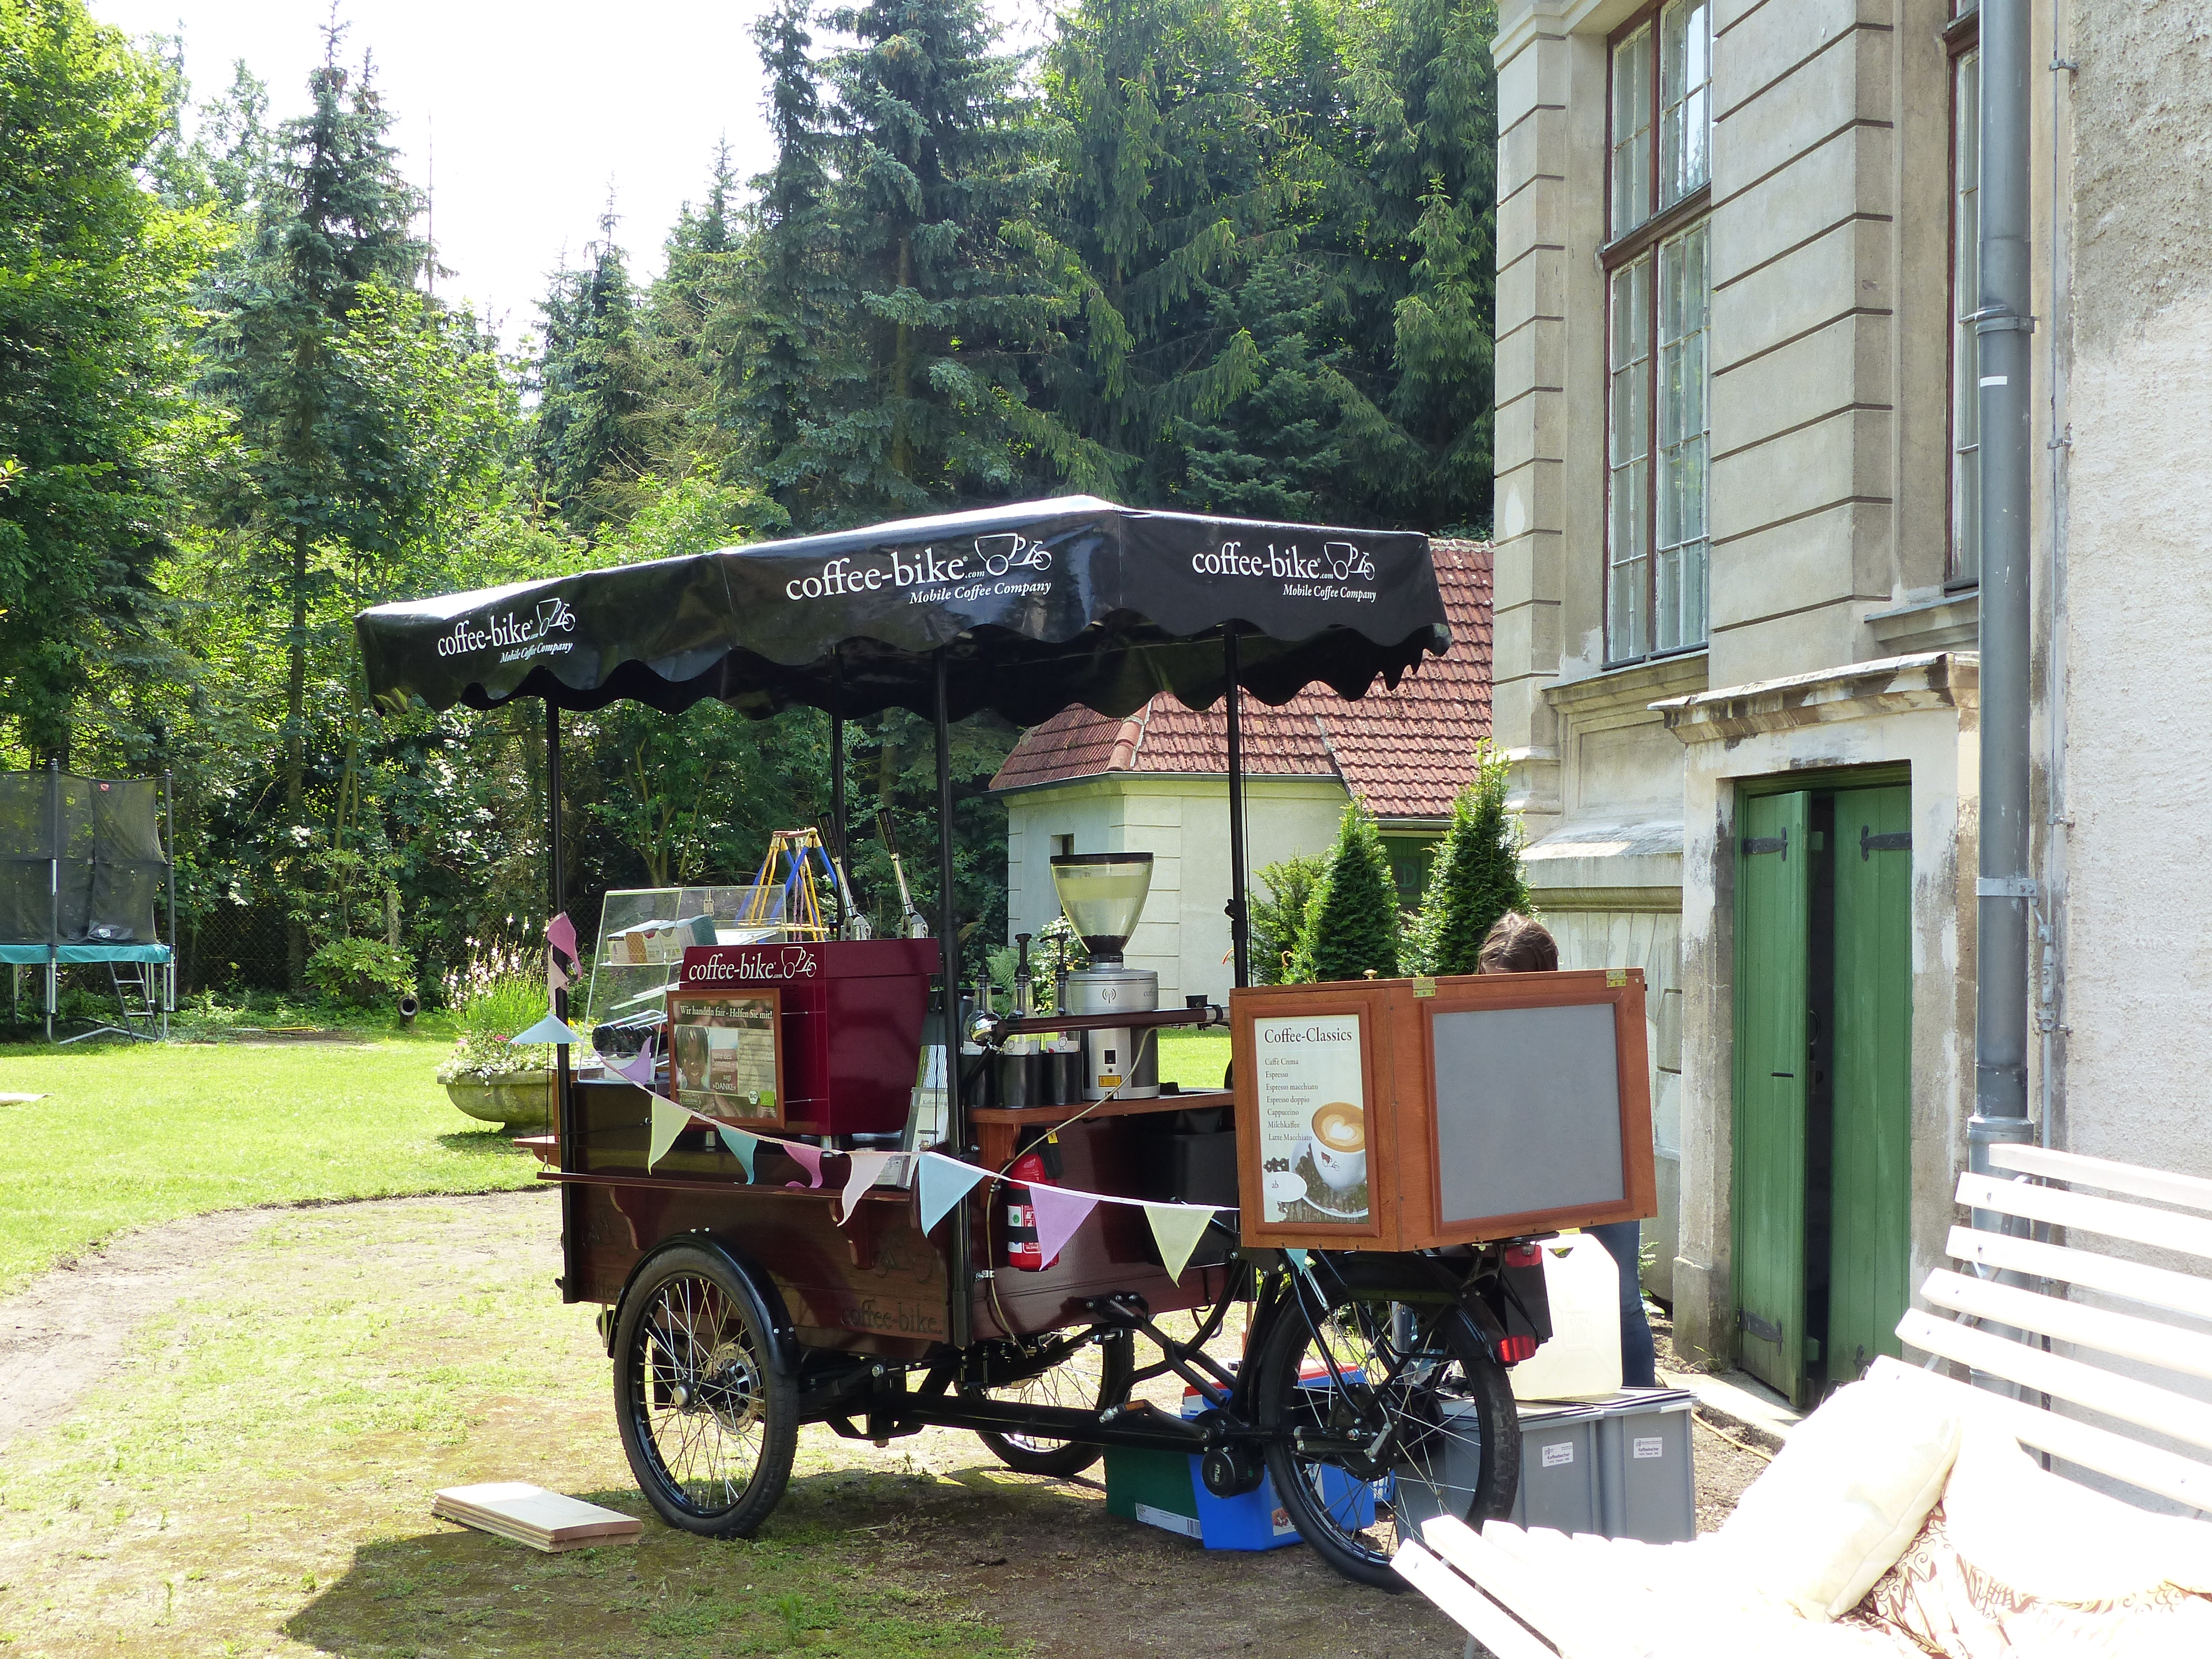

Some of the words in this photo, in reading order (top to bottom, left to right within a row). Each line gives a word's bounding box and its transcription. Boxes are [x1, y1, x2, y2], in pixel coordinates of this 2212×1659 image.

[909, 588, 951, 604] Mobile
[954, 586, 991, 602] Coffee
[994, 581, 1051, 599] Company
[1282, 584, 1312, 597] Mobile
[1313, 586, 1338, 601] Coffee
[1340, 587, 1376, 603] Company
[500, 649, 521, 663] Mobile
[521, 644, 536, 660] Coffee
[537, 641, 573, 655] Company
[680, 1005, 691, 1015] Wir
[691, 1006, 714, 1016] handeln
[715, 1007, 725, 1016] fair
[729, 1008, 749, 1018] Helfen
[749, 1009, 758, 1019] Sie
[759, 1011, 773, 1019] mit!
[1264, 1027, 1352, 1043] Coffee-Classics
[1266, 1071, 1288, 1079] Espresso
[1266, 1083, 1288, 1092] Espresso
[1267, 1096, 1290, 1105] Espresso
[1290, 1095, 1310, 1105] doppio
[1267, 1108, 1299, 1117] Cappuccino
